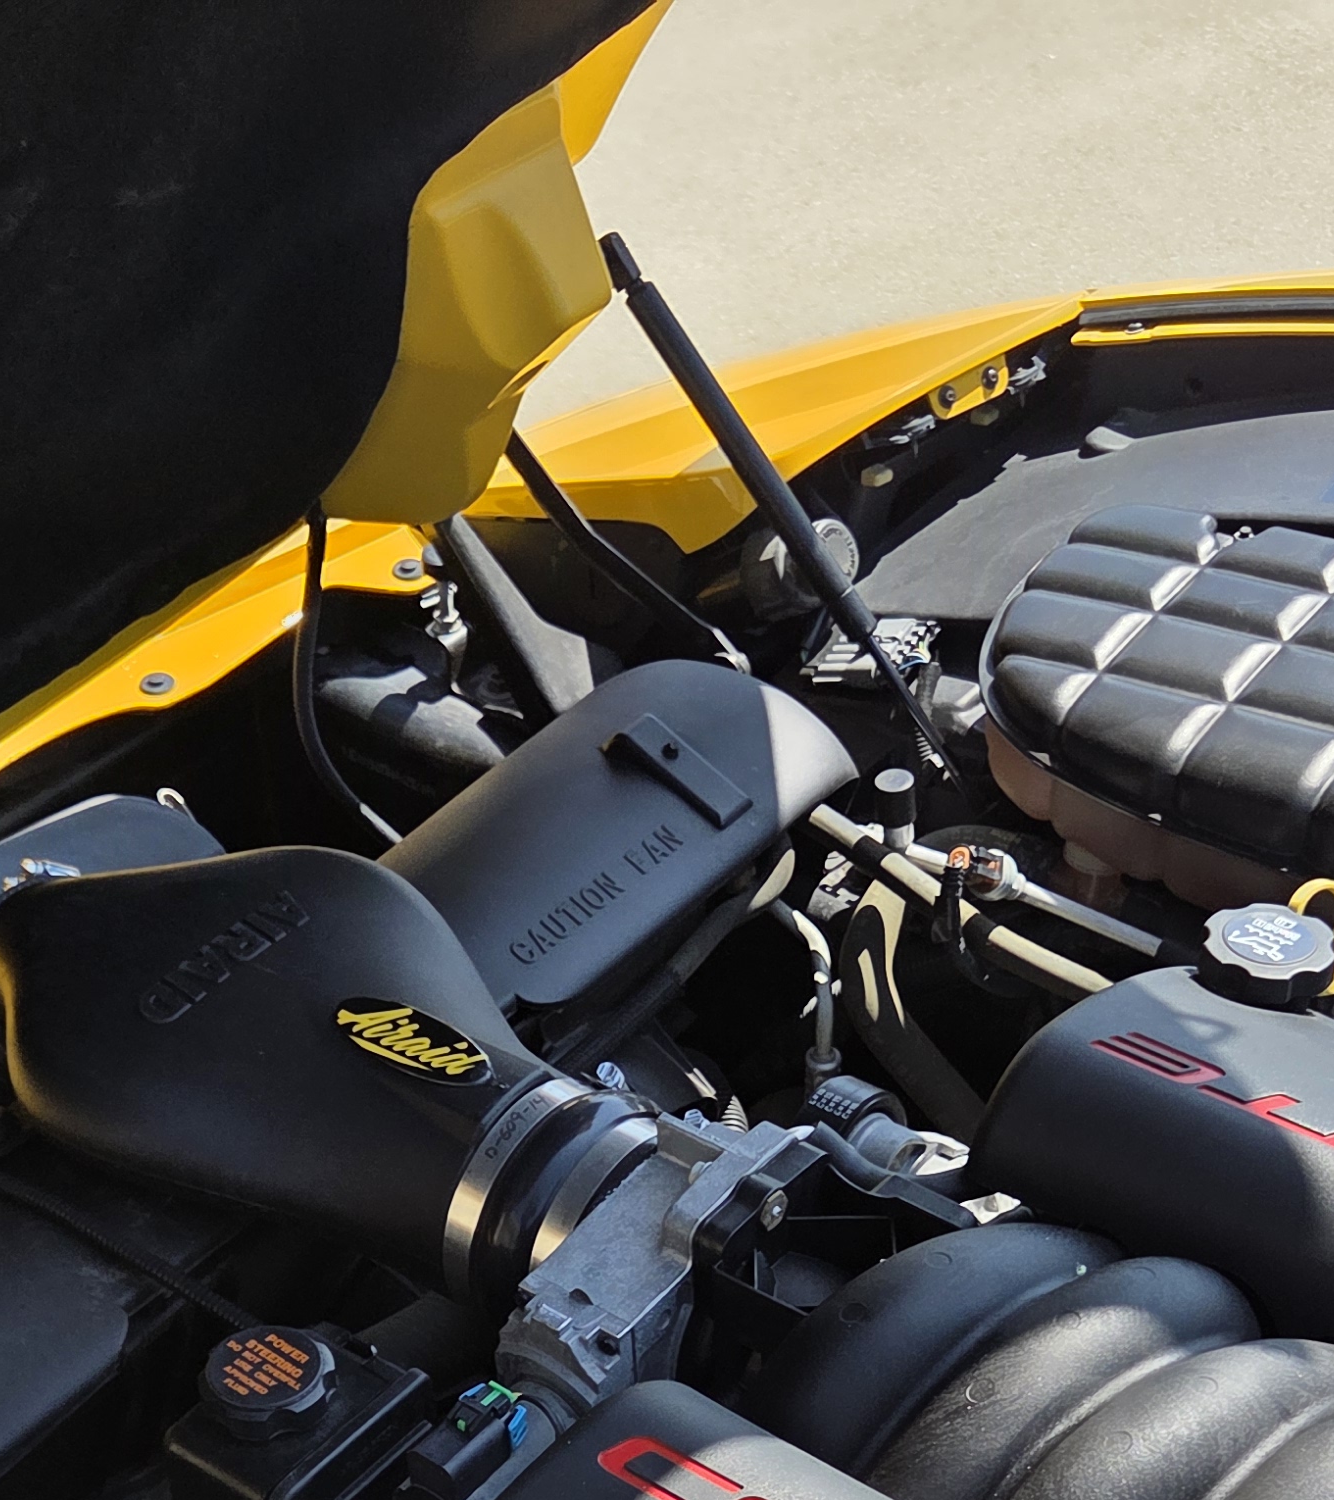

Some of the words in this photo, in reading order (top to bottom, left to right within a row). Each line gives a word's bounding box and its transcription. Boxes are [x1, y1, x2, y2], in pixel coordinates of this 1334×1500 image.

[509, 870, 625, 968] CAUTION
[625, 823, 686, 877] FAN
[137, 886, 313, 1027] AIRAID
[336, 1007, 486, 1076] Airaid
[226, 1339, 243, 1352] DO
[241, 1350, 263, 1364] NOT
[262, 1363, 302, 1391] OVERFILL
[245, 1338, 304, 1379] STEERING
[264, 1333, 310, 1364] POWER
[222, 1365, 269, 1395] APPROVED
[222, 1377, 250, 1396] FLUID
[233, 1358, 254, 1373] USE
[253, 1371, 279, 1387] ONLY
